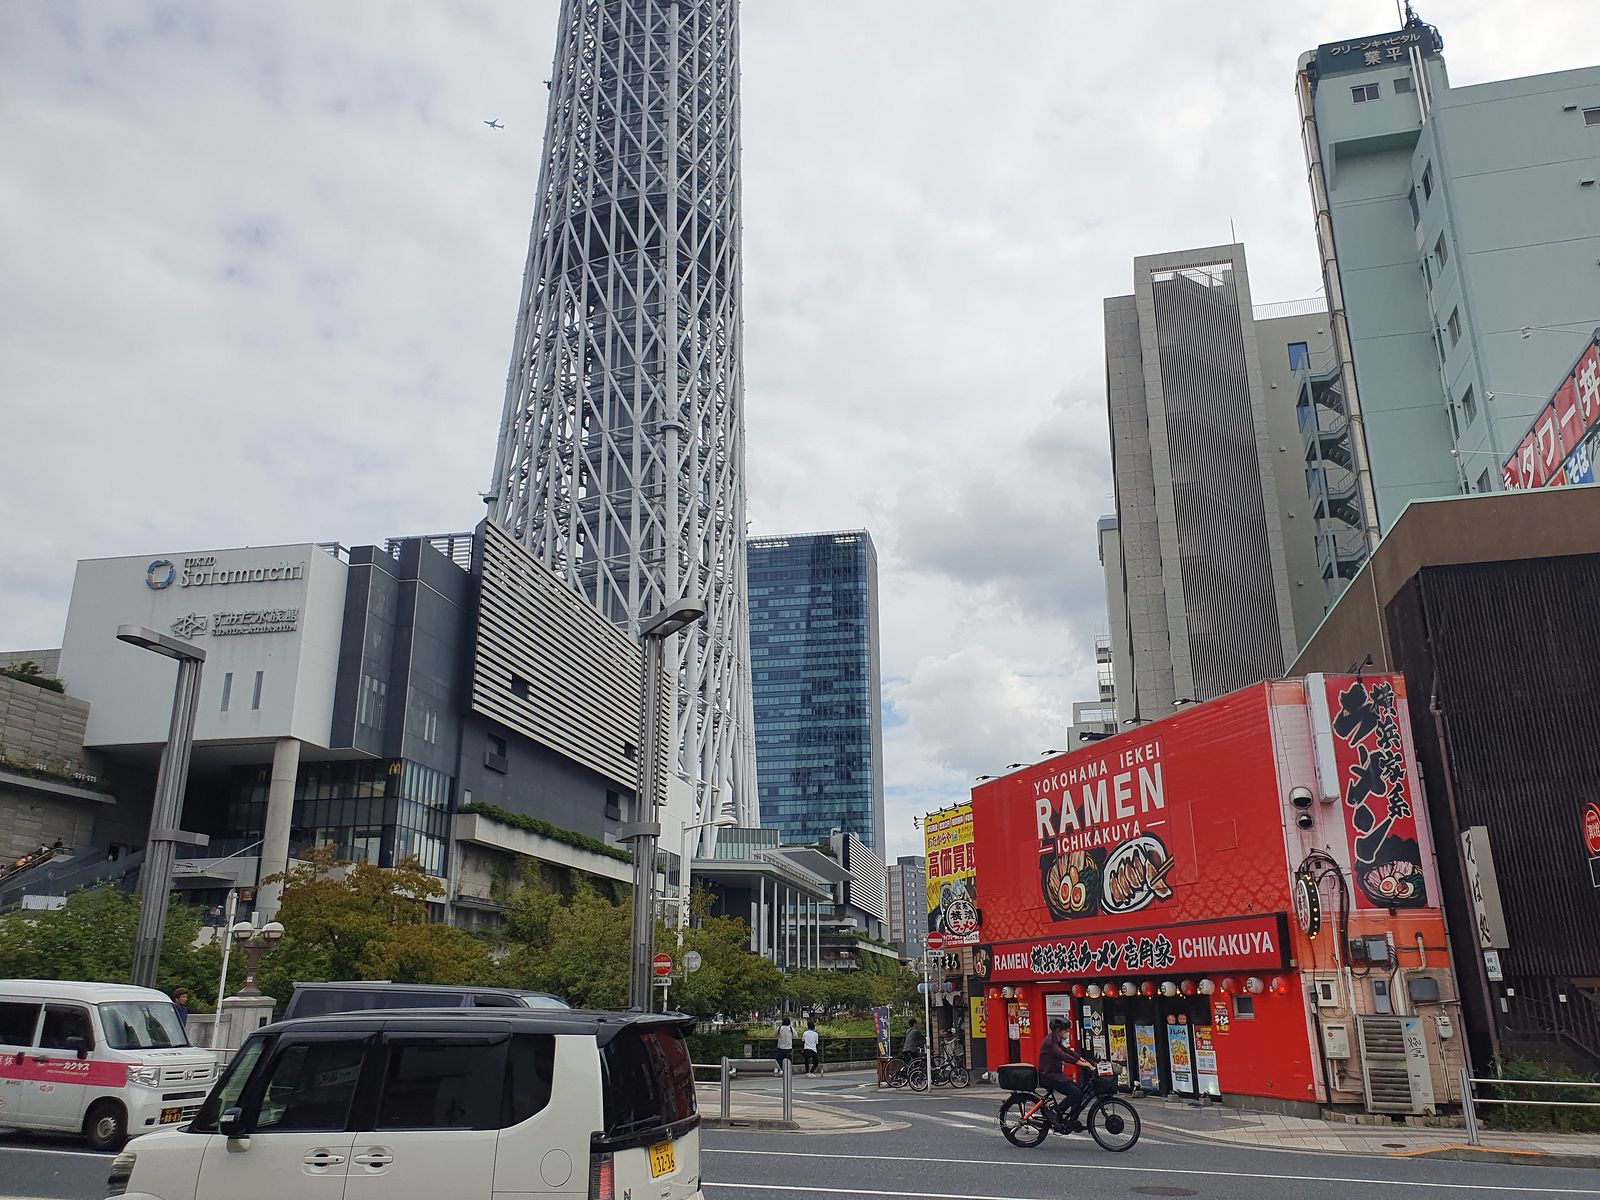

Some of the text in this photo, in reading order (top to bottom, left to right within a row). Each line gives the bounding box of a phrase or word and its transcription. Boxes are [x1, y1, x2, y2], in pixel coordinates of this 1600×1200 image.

[1363, 46, 1403, 66] 業平
[1568, 443, 1591, 484] そば
[181, 561, 305, 588] Solamachi
[185, 556, 216, 569] TOKYO
[213, 608, 299, 627] すみだ水族館
[1368, 680, 1412, 820] 横浜家系
[1034, 741, 1160, 796] YOKOHAMA IEKEI
[1035, 762, 1165, 840] RAMEN
[1057, 820, 1142, 854] ICHIKAKUYA
[928, 841, 977, 880] 高価買取
[952, 919, 977, 934] ラーメン
[993, 952, 1028, 971] RAMEN
[1178, 930, 1274, 959] ICHIKAKUYA
[63, 1061, 90, 1071] カクヤス
